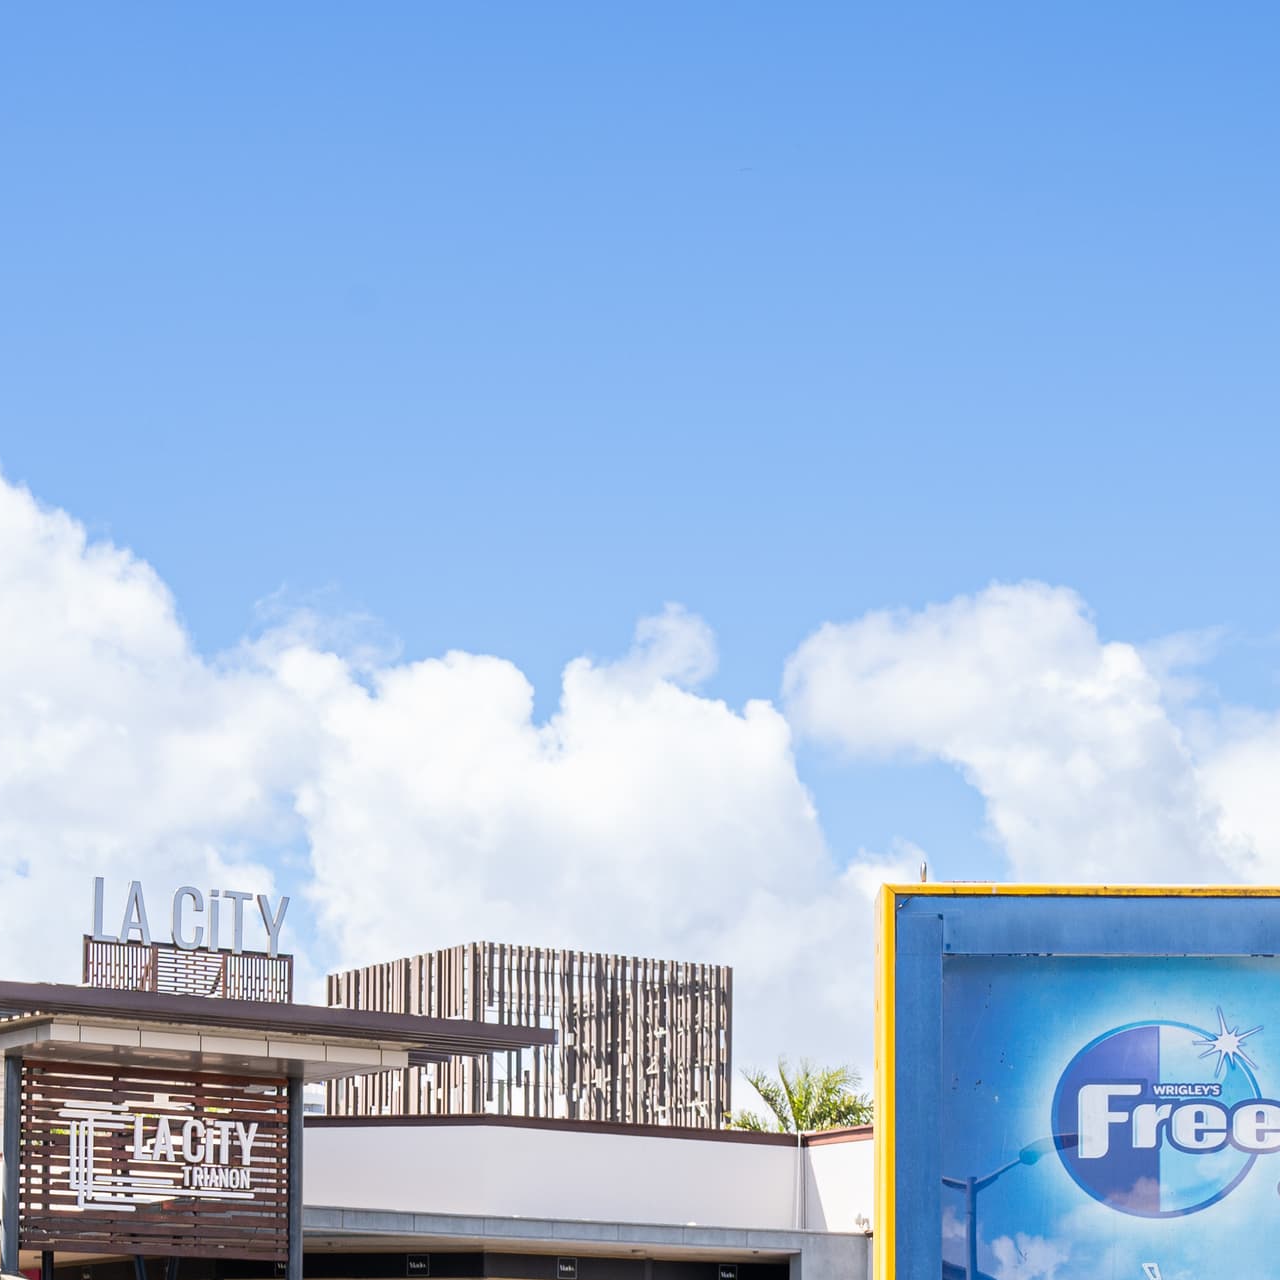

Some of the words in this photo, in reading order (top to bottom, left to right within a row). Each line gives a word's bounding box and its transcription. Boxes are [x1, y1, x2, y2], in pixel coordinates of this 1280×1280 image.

[92, 876, 152, 947] LA
[1152, 1084, 1221, 1096] WRIGLEY'S
[133, 1115, 176, 1162] LA
[181, 1165, 251, 1189] TRIANON
